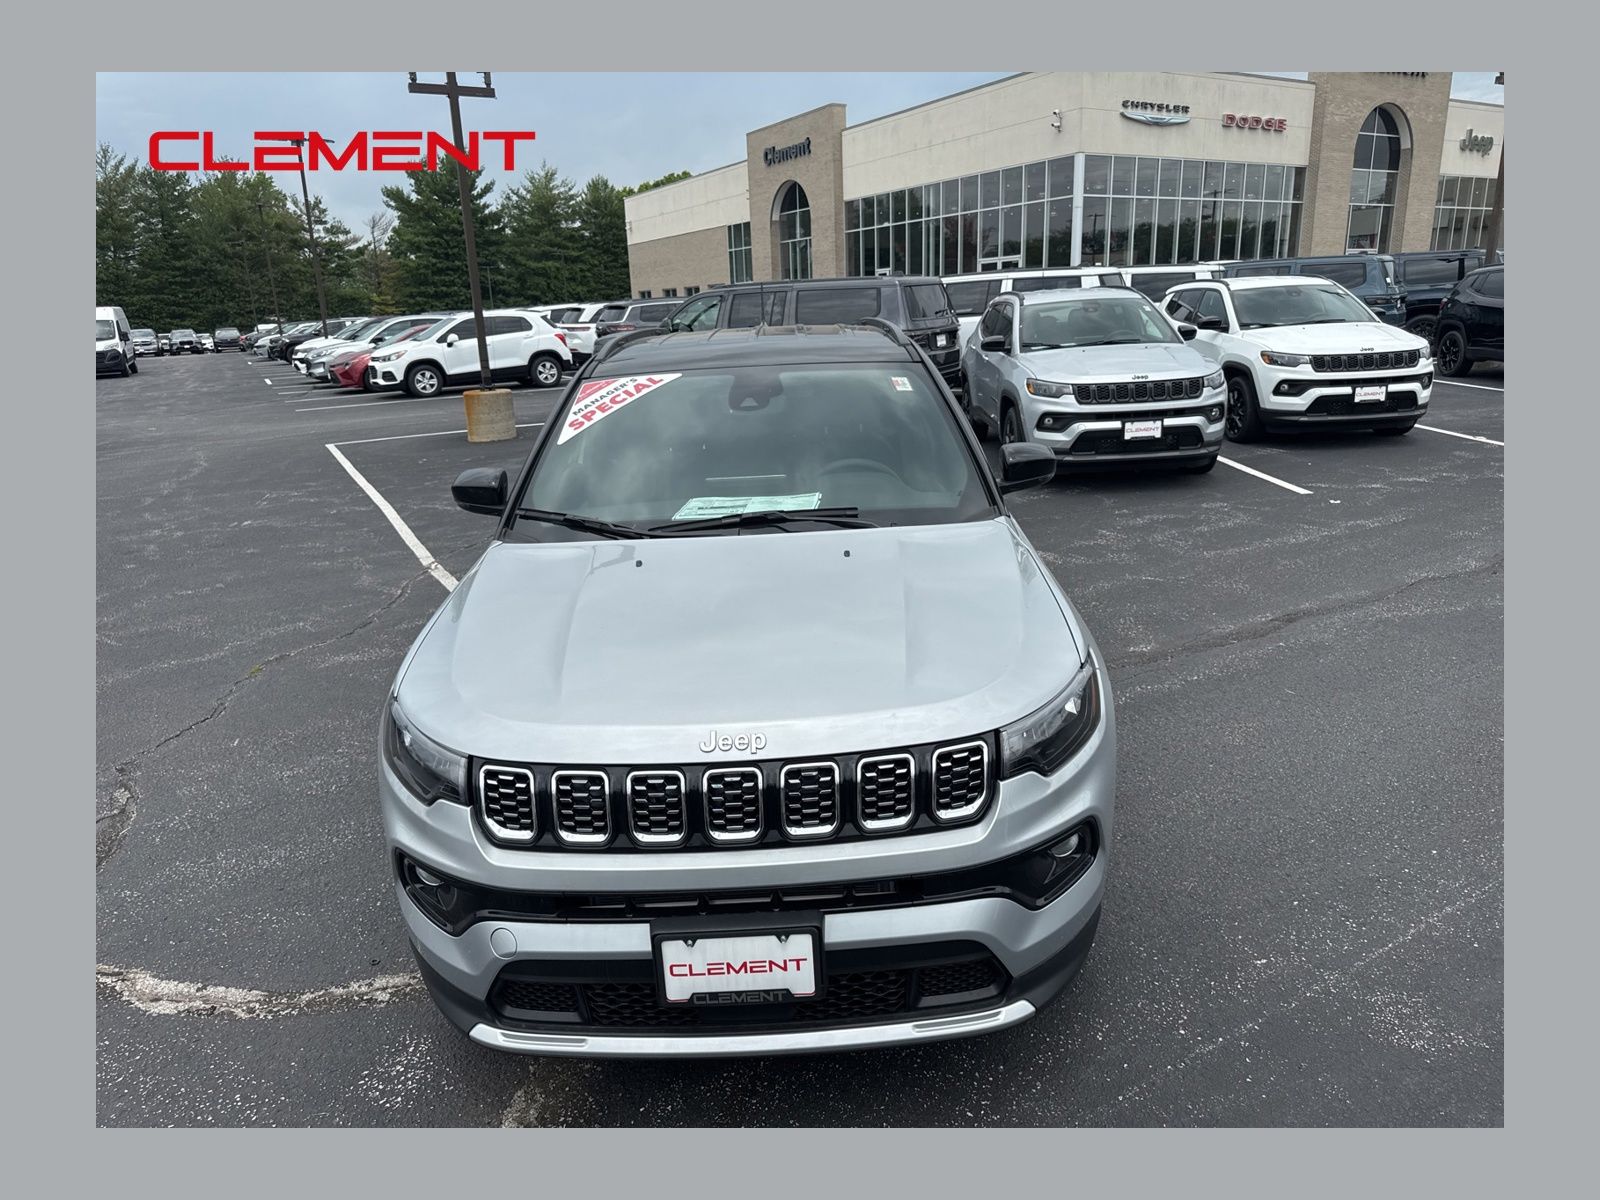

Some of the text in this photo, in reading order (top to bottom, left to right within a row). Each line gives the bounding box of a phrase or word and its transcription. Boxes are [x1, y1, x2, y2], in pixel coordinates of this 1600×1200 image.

[1121, 99, 1190, 115] CHRYSLER
[1222, 113, 1288, 132] DODGE
[763, 136, 811, 167] Clement
[1459, 128, 1494, 158] Jeep
[568, 376, 665, 431] SPECIAL
[572, 377, 639, 416] MANAGER'S
[699, 729, 768, 755] Jeep
[669, 957, 808, 977] CLEMENT
[693, 990, 787, 1005] CLEMENT
